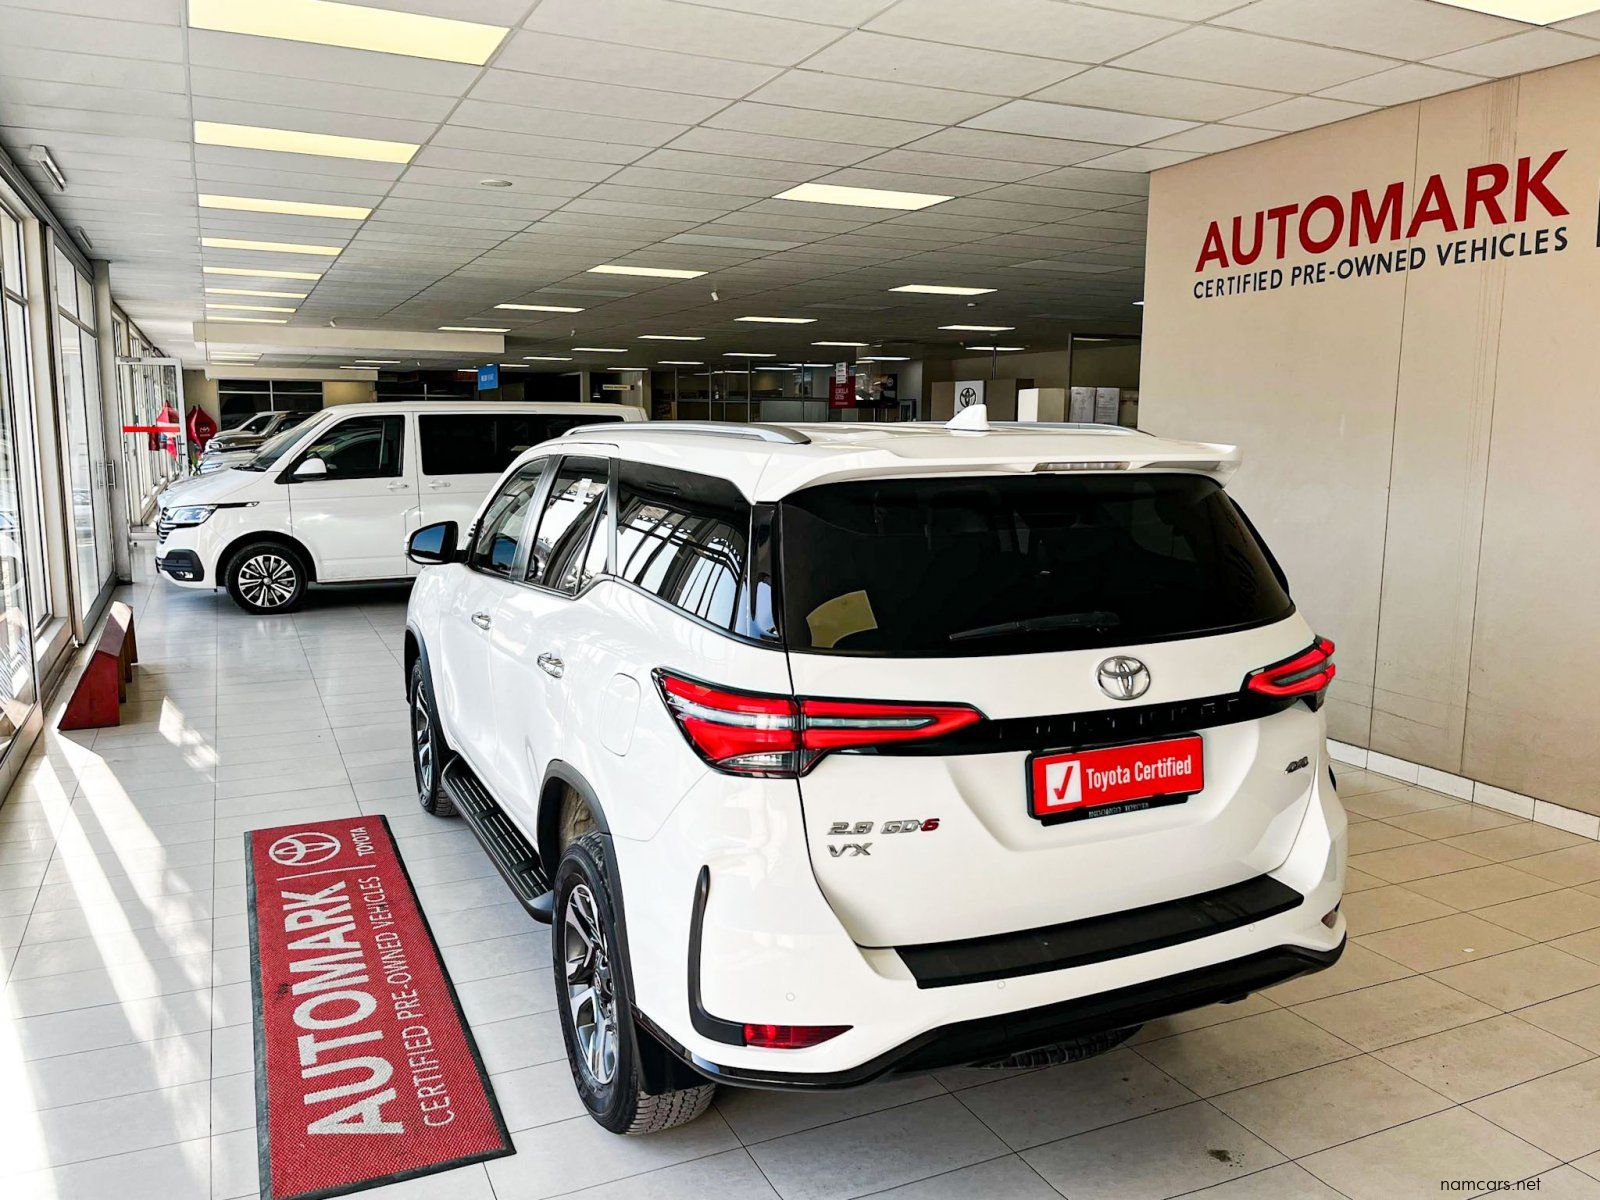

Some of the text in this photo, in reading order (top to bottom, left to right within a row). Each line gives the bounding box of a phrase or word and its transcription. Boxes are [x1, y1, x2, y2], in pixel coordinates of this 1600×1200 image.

[1194, 149, 1570, 273] AUTOMARK
[1193, 226, 1568, 299] CERTIFIED PRE-OWNED VEHICLES
[1085, 754, 1192, 793] Toyota Certified
[350, 826, 376, 857] TOYOTA
[827, 821, 874, 836] 2.8
[827, 842, 873, 857] VX
[281, 879, 405, 1136] AUTOMARK
[358, 876, 455, 1128] CERTIFIED PRE-OWNED VEHICLES
